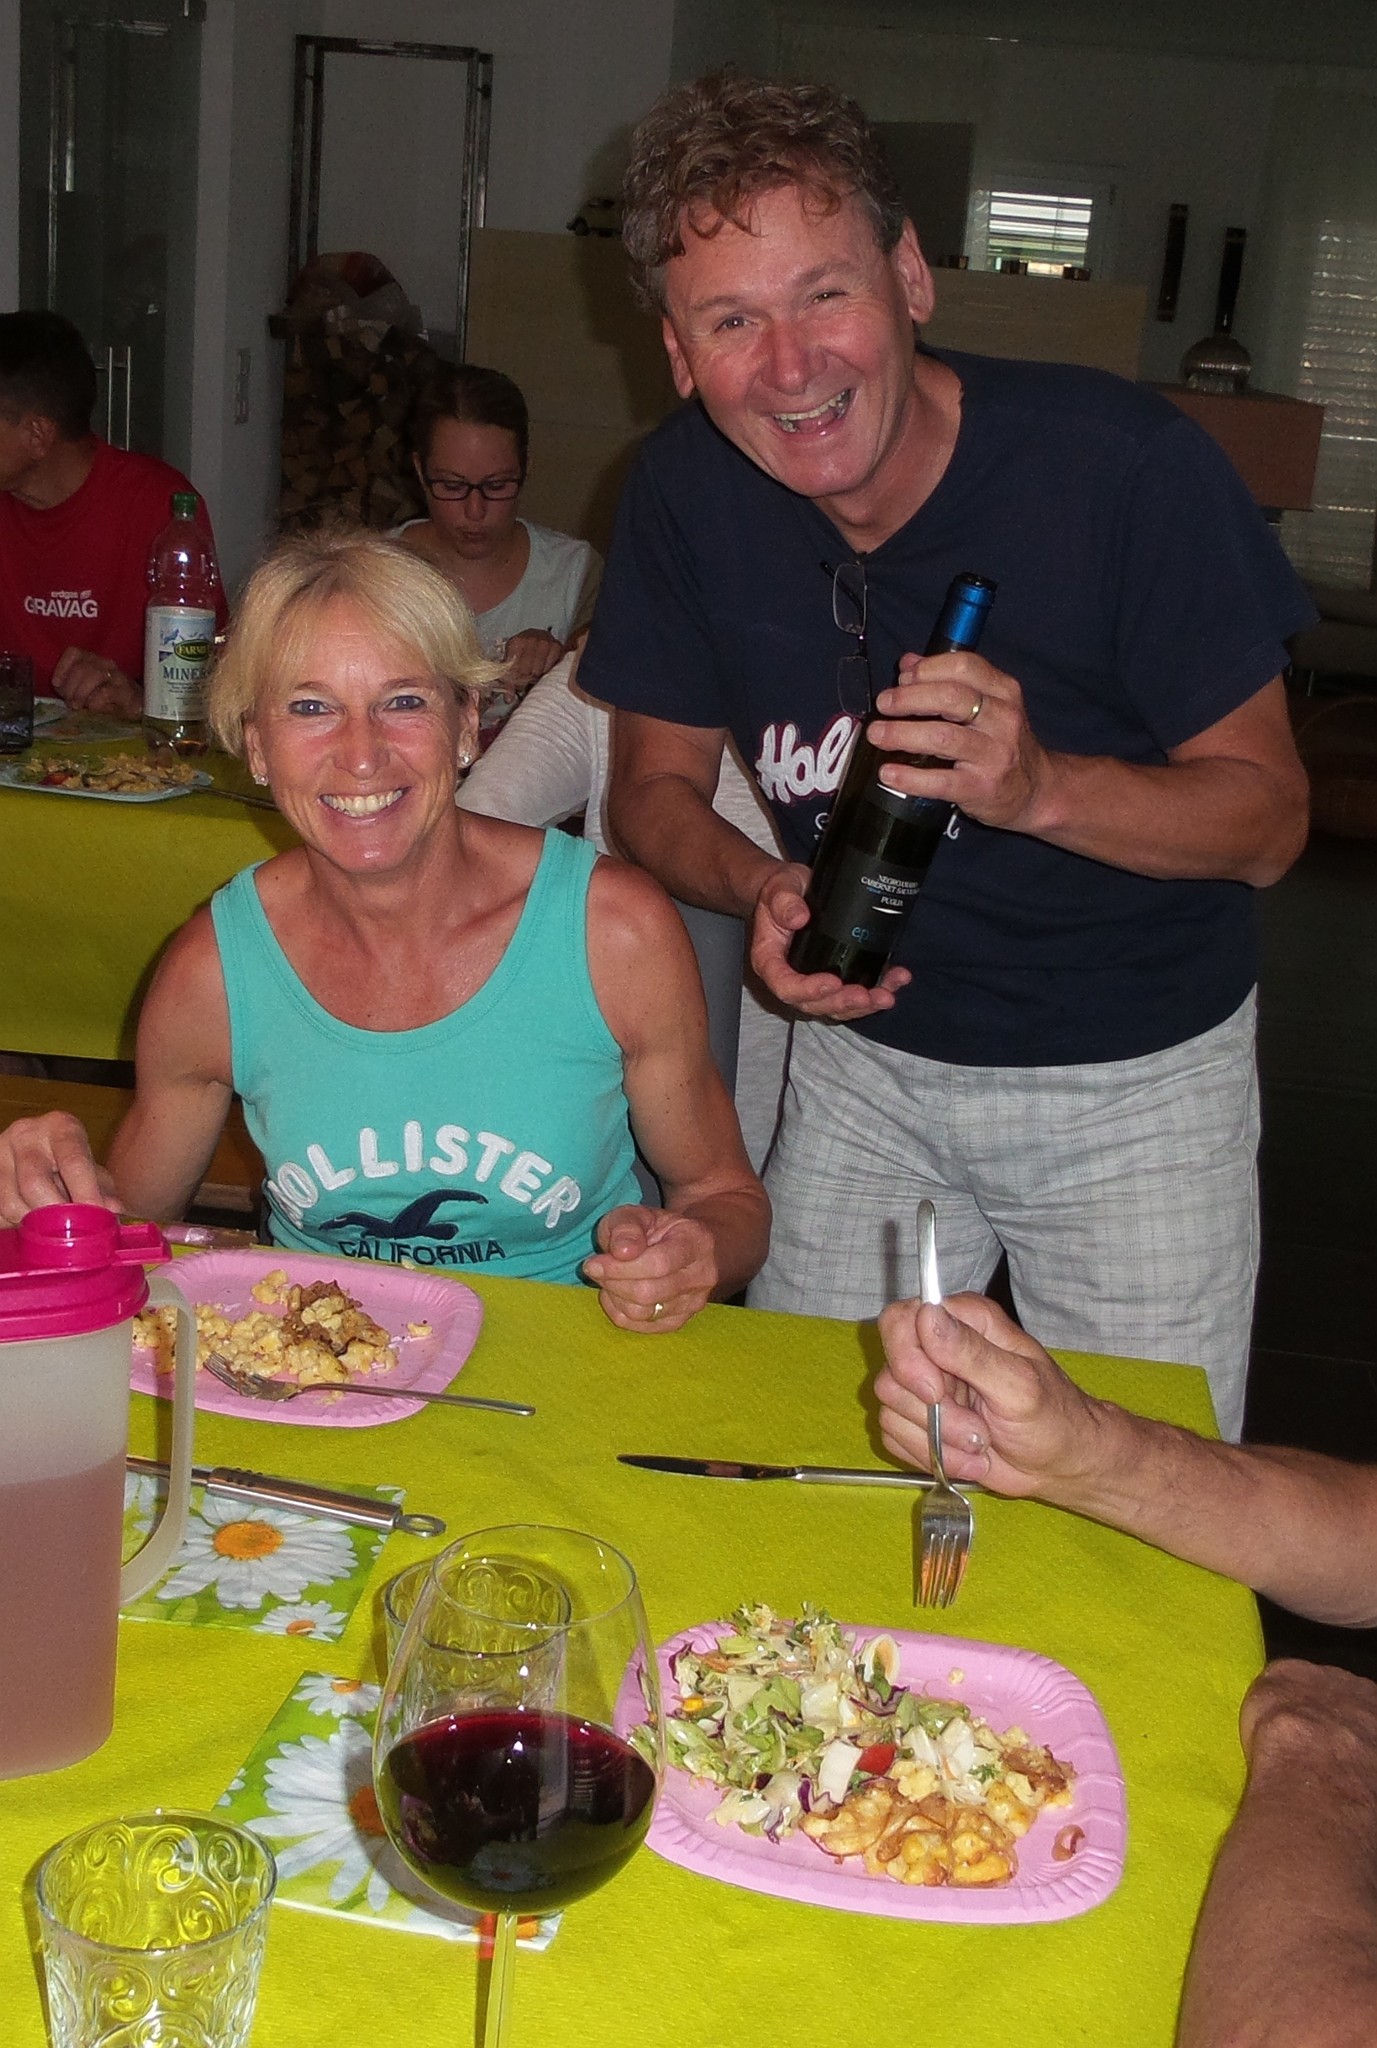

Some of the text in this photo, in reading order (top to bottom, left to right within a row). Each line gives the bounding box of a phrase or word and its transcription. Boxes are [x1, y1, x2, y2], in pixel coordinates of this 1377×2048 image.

[51, 590, 78, 600] erdgas
[24, 595, 98, 618] GRAVAG
[178, 645, 208, 655] FARM
[163, 666, 209, 681] MINER
[267, 1119, 582, 1230] HOLLISTER
[338, 1240, 506, 1266] CALIFORNIA
